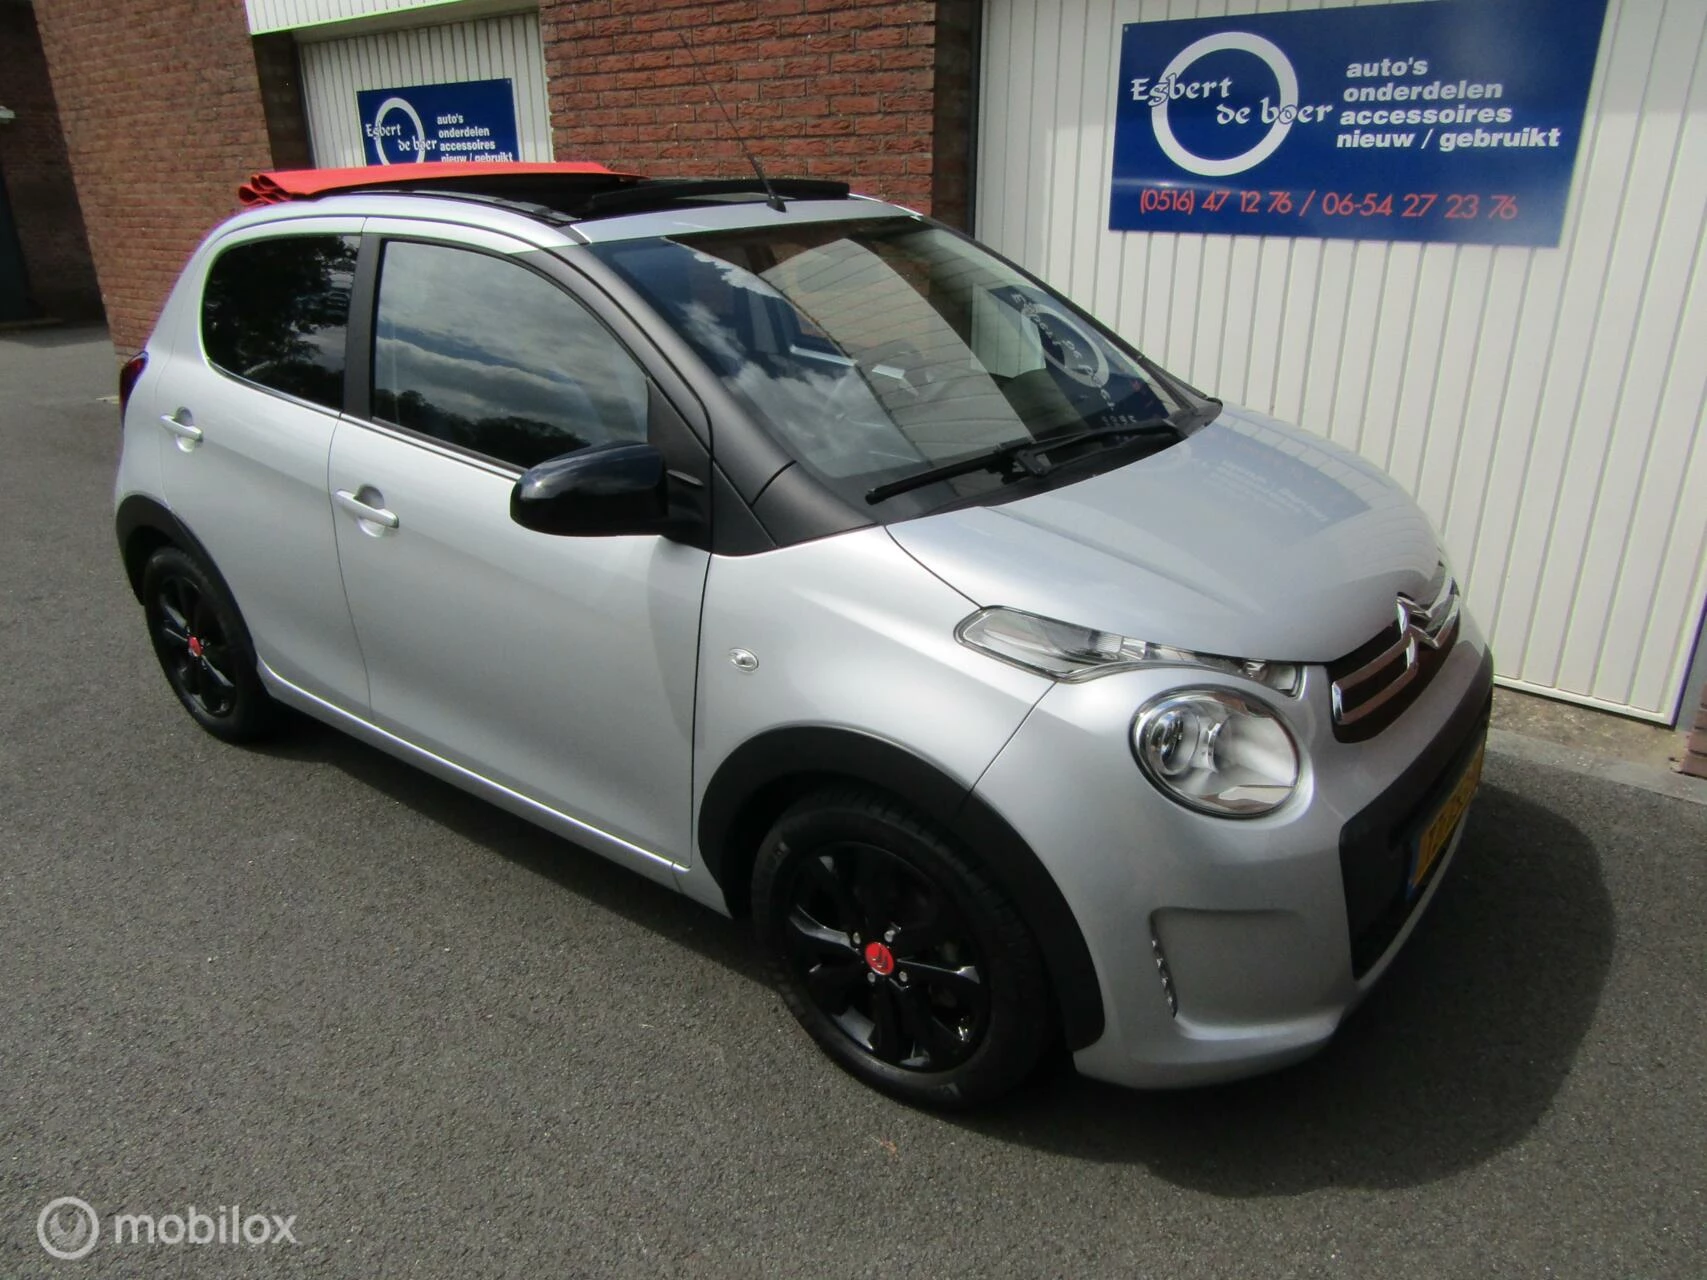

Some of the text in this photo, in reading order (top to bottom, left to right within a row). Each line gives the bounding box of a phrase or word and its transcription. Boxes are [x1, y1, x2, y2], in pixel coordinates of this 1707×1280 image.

[1346, 57, 1428, 78] auto's
[1130, 72, 1232, 107] Egbert
[1343, 80, 1503, 102] onderdelen
[437, 113, 464, 125] auto's
[1216, 97, 1333, 125] de boer
[1340, 104, 1512, 125] accessoires
[438, 126, 490, 138] onderdelen
[1336, 127, 1561, 152] nieuw / gebruikt
[397, 135, 437, 151] de boer
[440, 139, 496, 151] accessoires
[1140, 189, 1519, 220] (0516) 47 12 76 / 06-54 27 23 76
